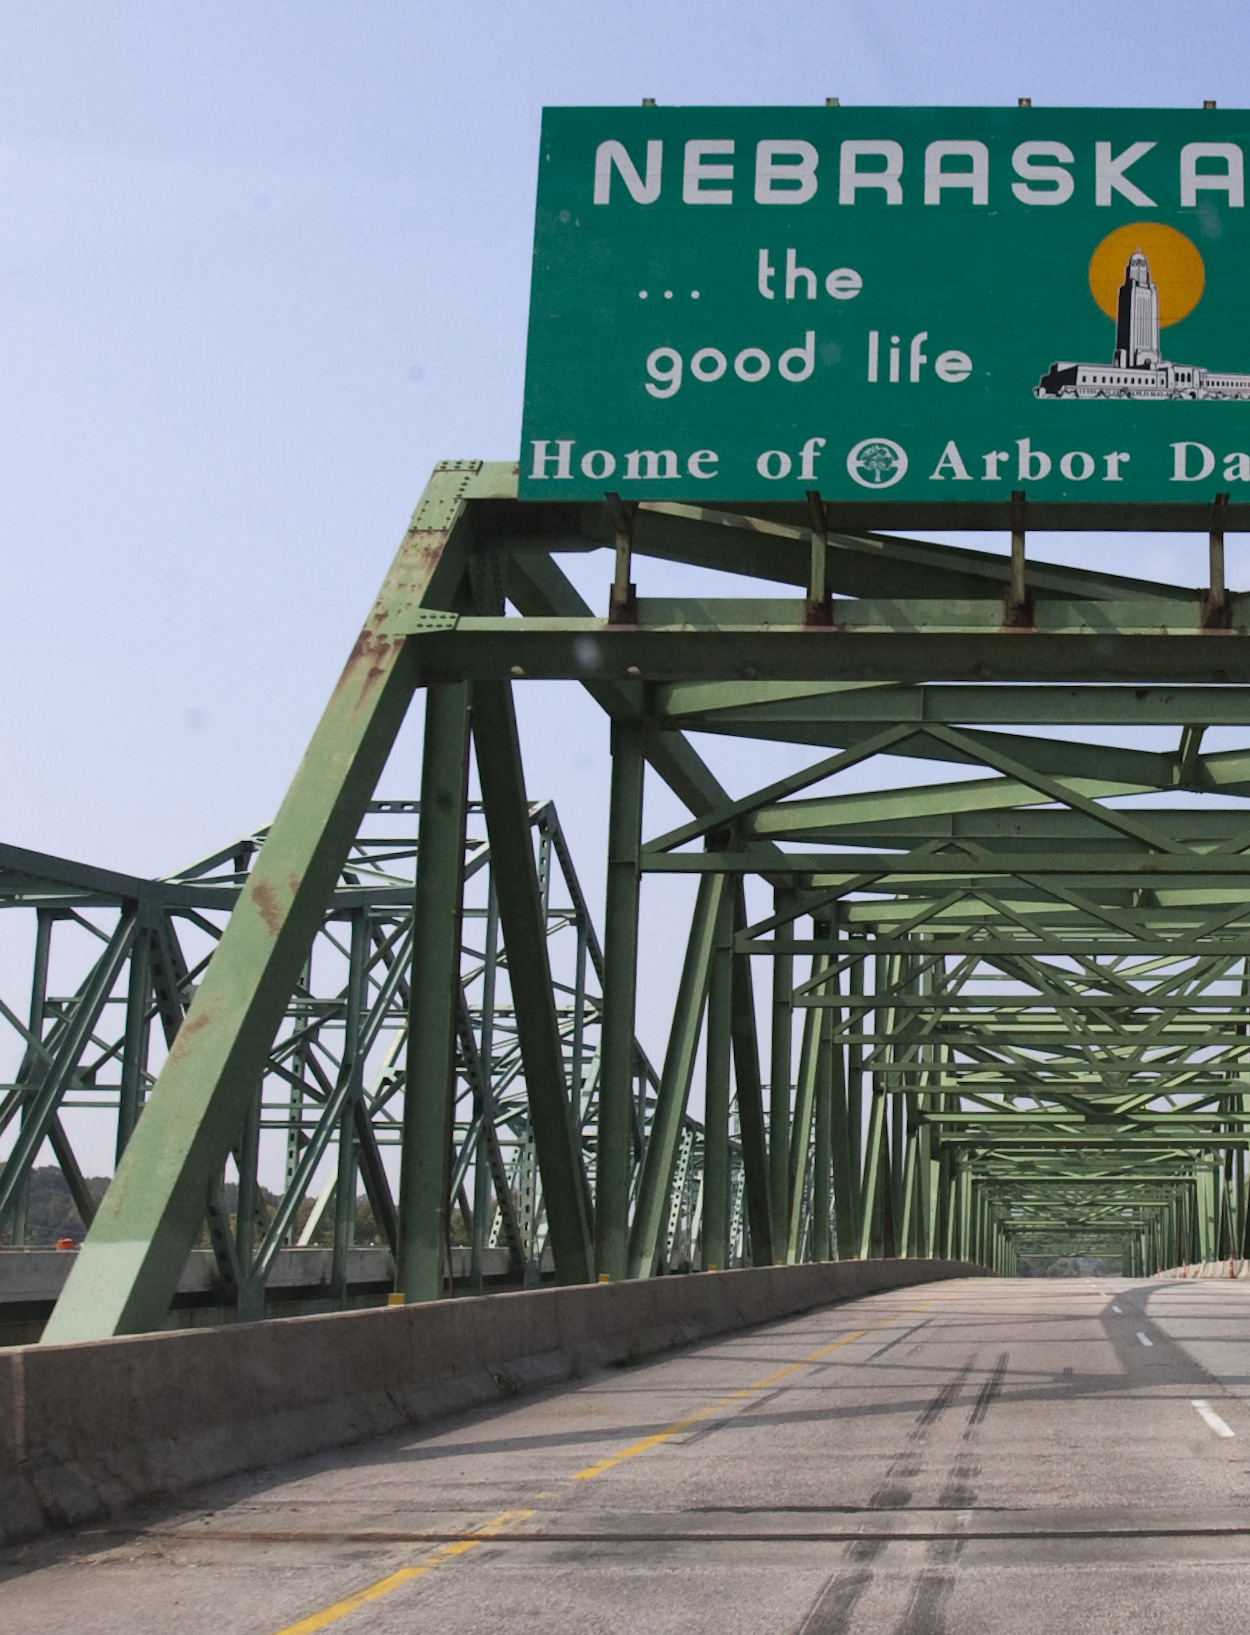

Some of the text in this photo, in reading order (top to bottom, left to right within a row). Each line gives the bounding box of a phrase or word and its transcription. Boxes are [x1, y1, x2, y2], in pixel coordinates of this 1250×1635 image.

[593, 140, 1244, 207] NEBRASKA
[758, 248, 863, 300] the
[645, 330, 973, 399] good life
[528, 440, 719, 479] Home
[756, 437, 826, 480] of
[929, 437, 1130, 481] Arbor
